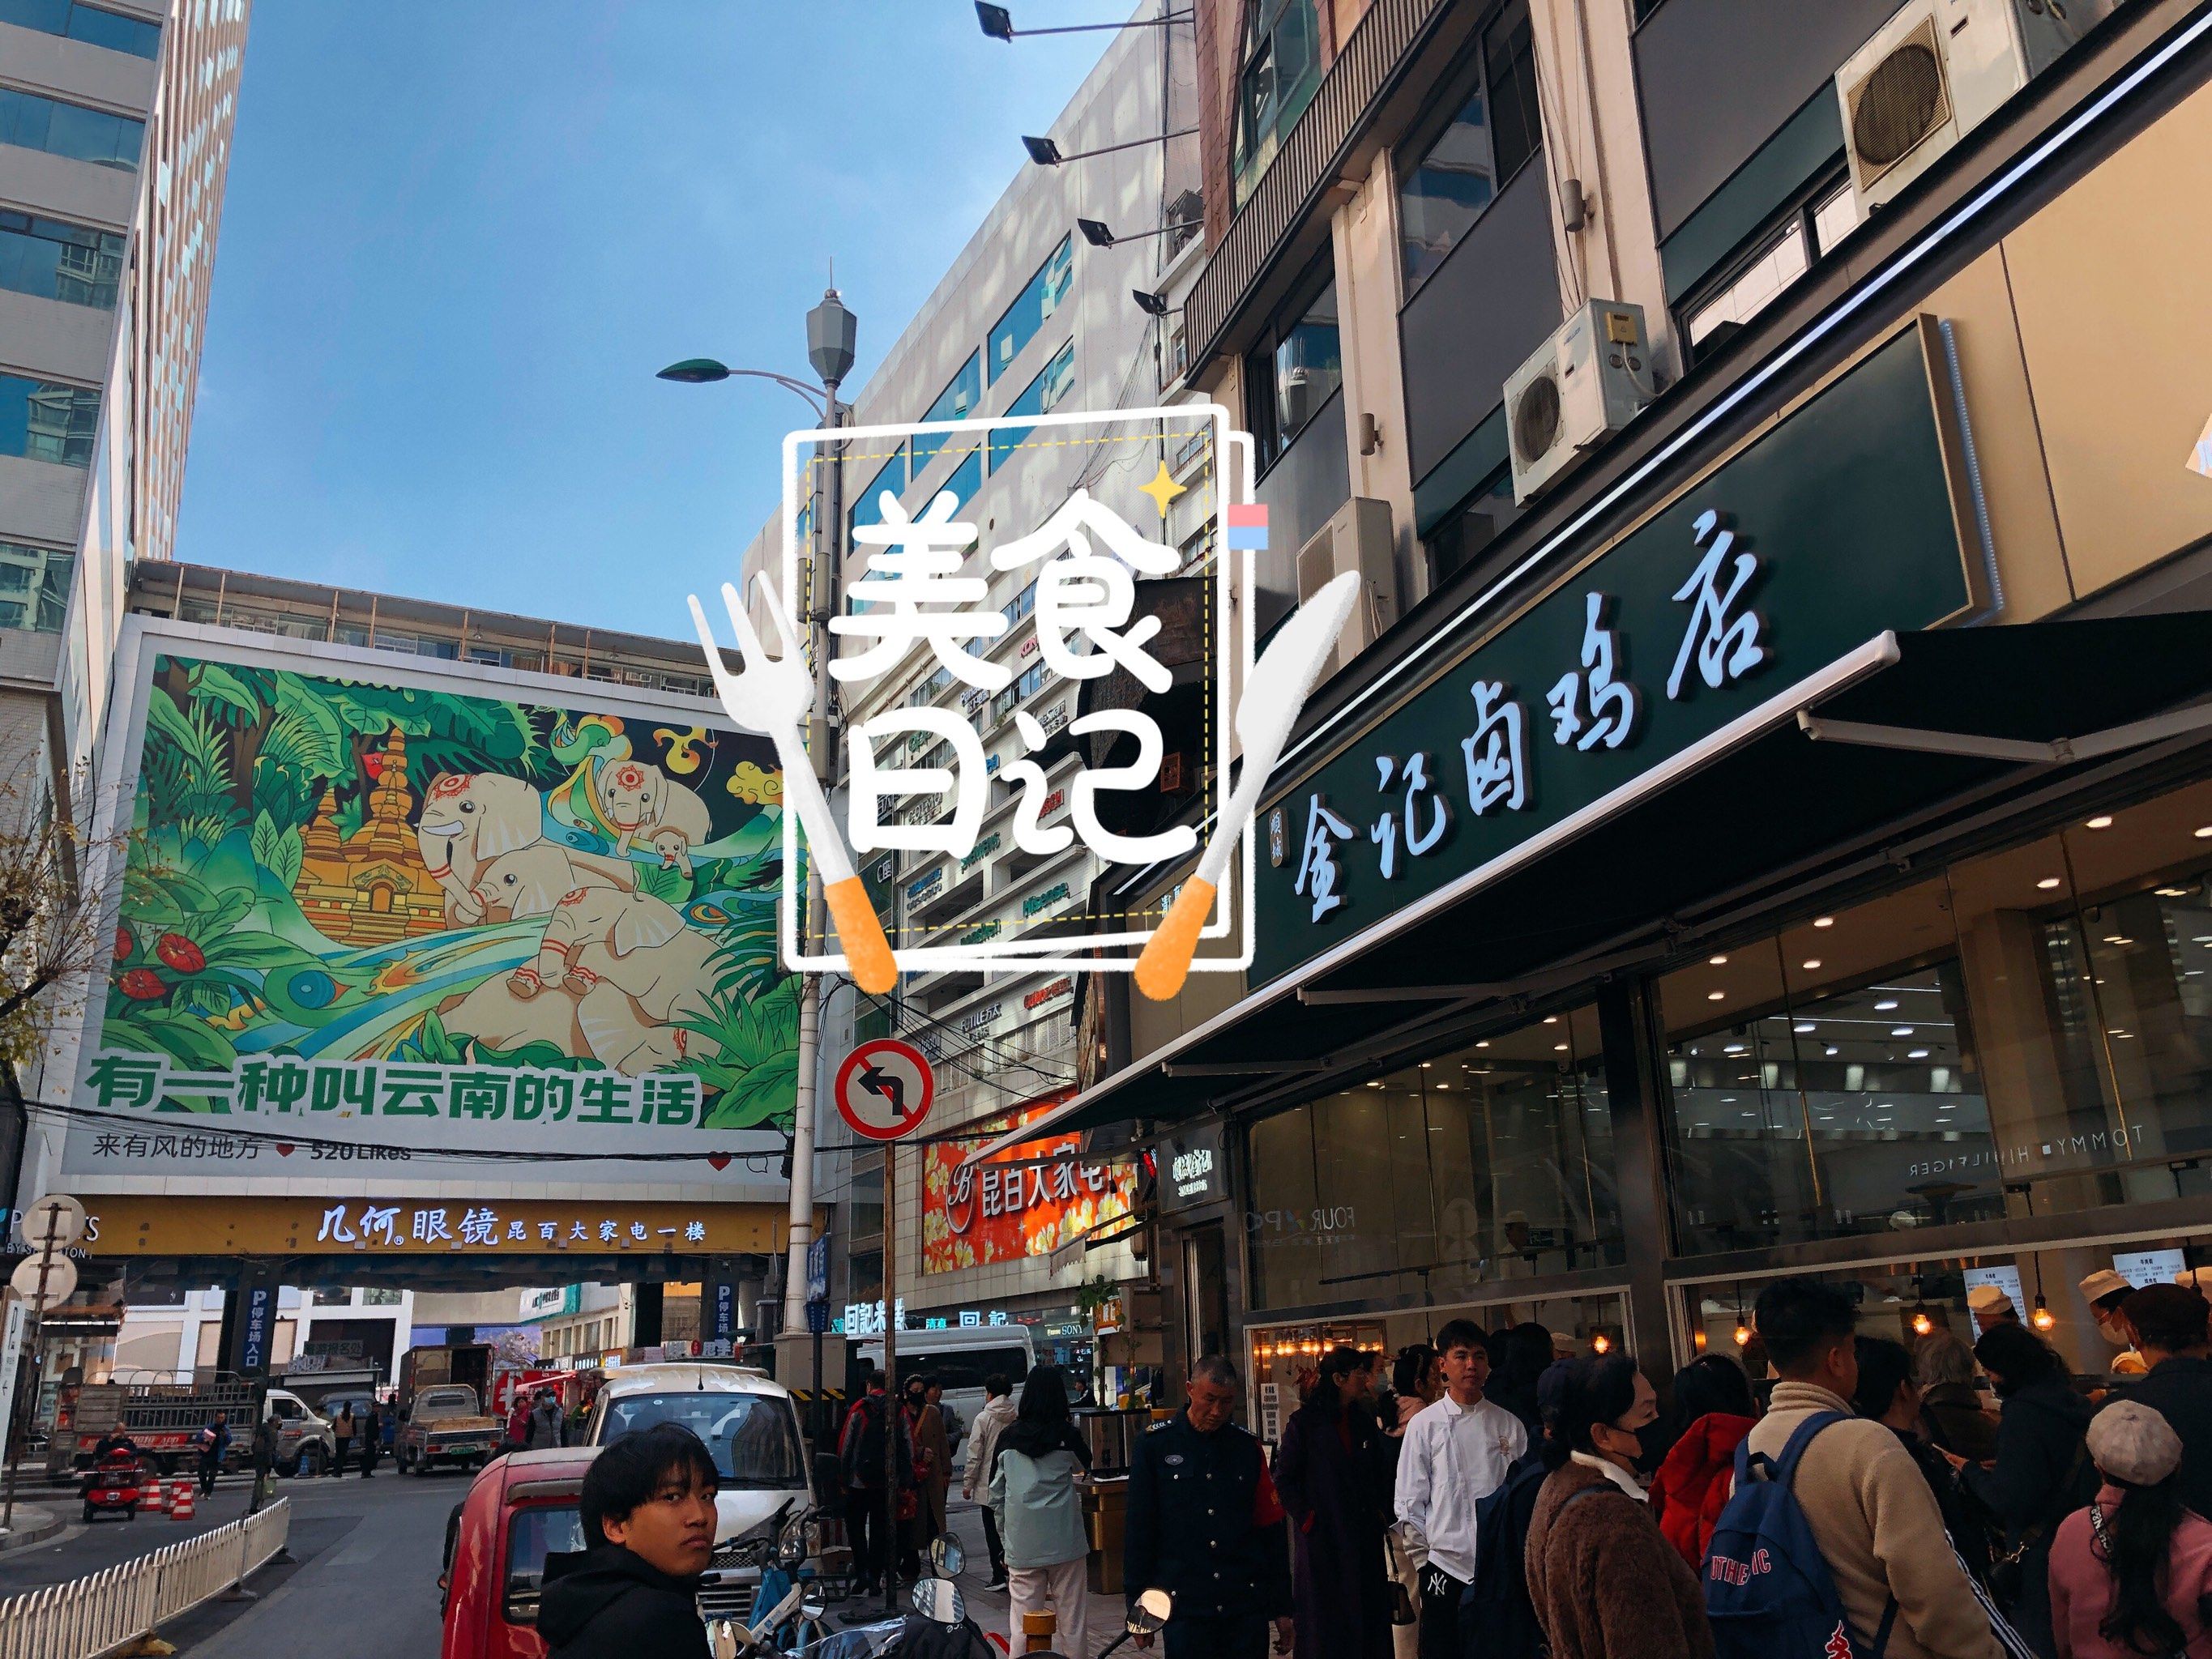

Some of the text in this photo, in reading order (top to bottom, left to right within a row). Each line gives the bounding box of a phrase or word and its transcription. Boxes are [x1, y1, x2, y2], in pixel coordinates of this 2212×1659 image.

[85, 1056, 695, 1126] 有一种叫云南的生活
[92, 1134, 259, 1160] 来有风的地方
[506, 1221, 707, 1243] 昆百大家电一楼
